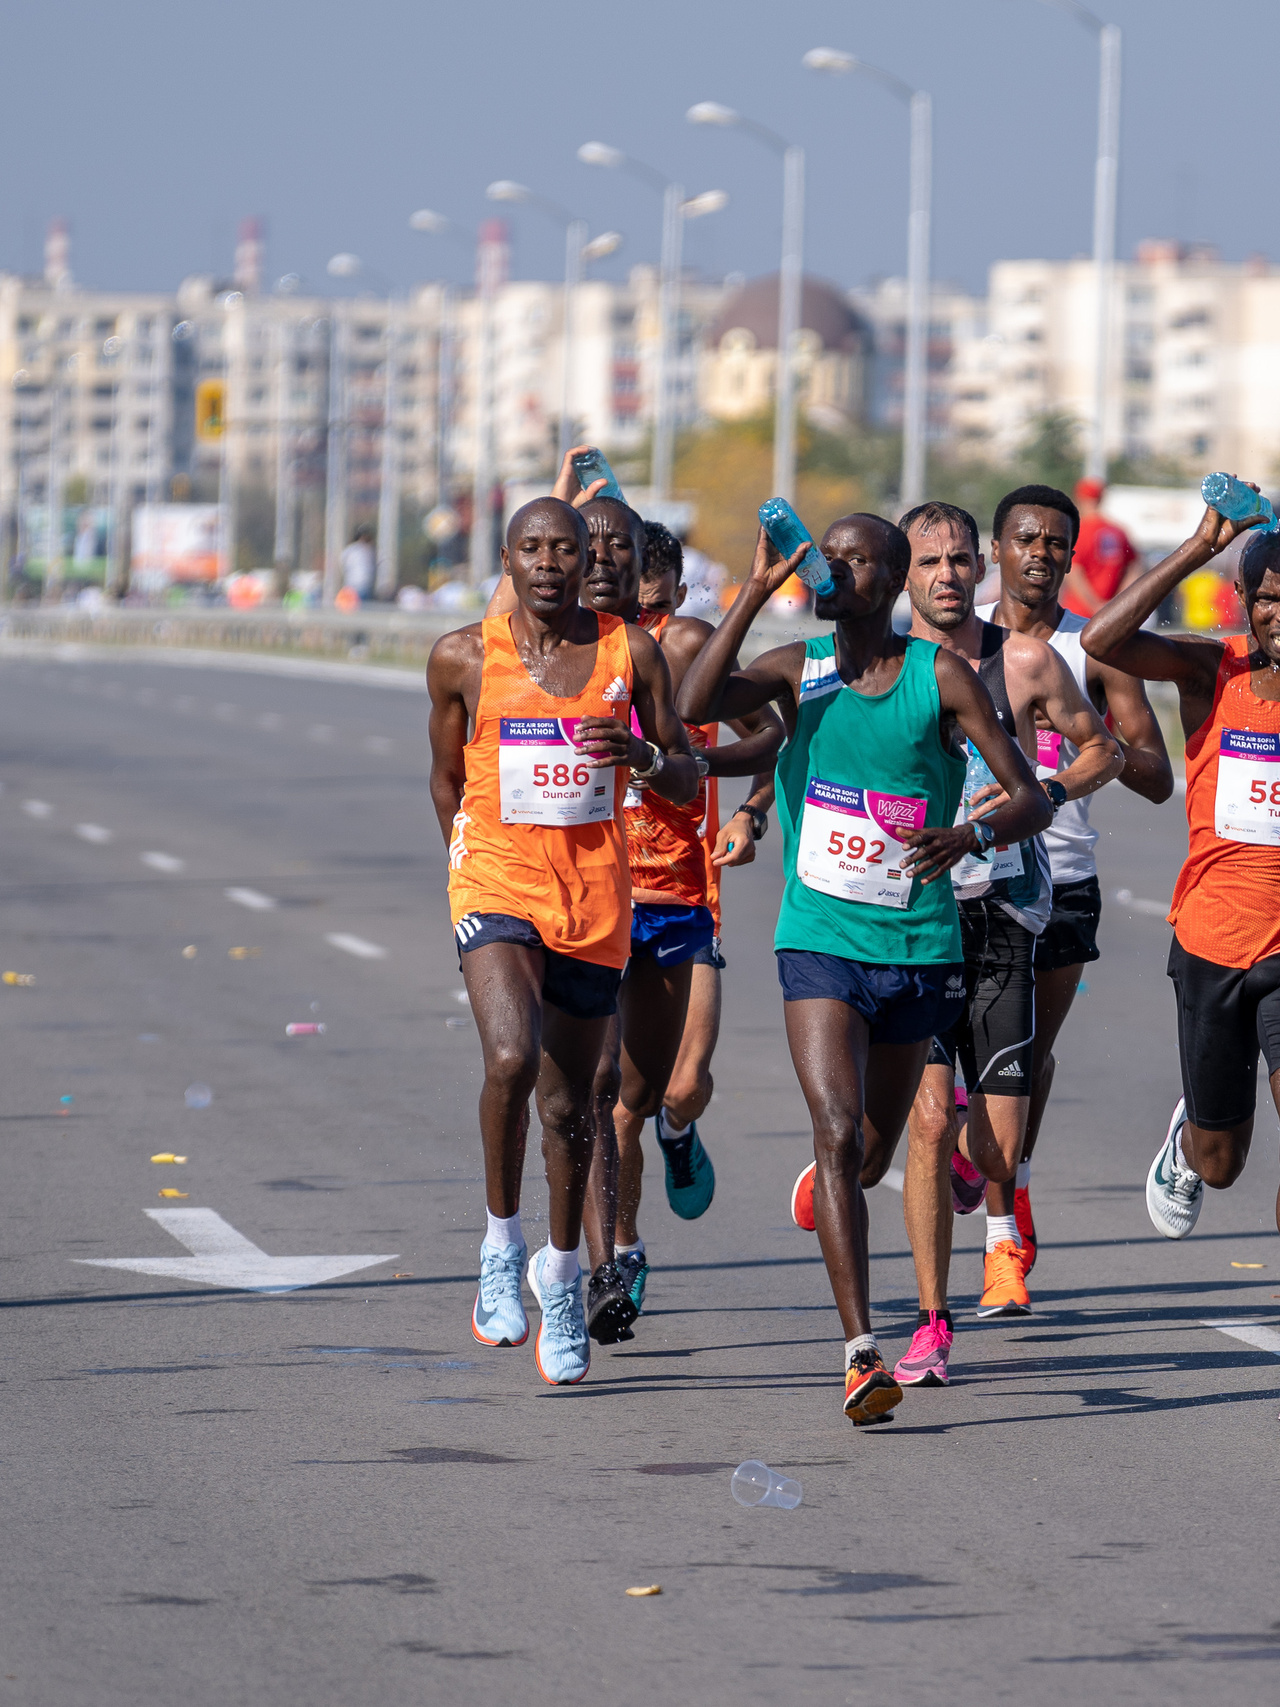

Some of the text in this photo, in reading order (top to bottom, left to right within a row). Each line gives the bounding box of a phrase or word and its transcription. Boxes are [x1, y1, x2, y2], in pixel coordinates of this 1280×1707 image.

[602, 691, 629, 701] adidas
[1229, 739, 1276, 751] MARATHON
[533, 763, 590, 787] 586
[542, 790, 581, 799] Duncan
[817, 783, 831, 791] WIZZ
[842, 790, 859, 798] SOFIA
[815, 789, 858, 805] MARATHON
[884, 819, 914, 827] wizzair.com
[828, 831, 885, 864] 592
[839, 861, 866, 873] Rono
[999, 861, 1014, 869] asics
